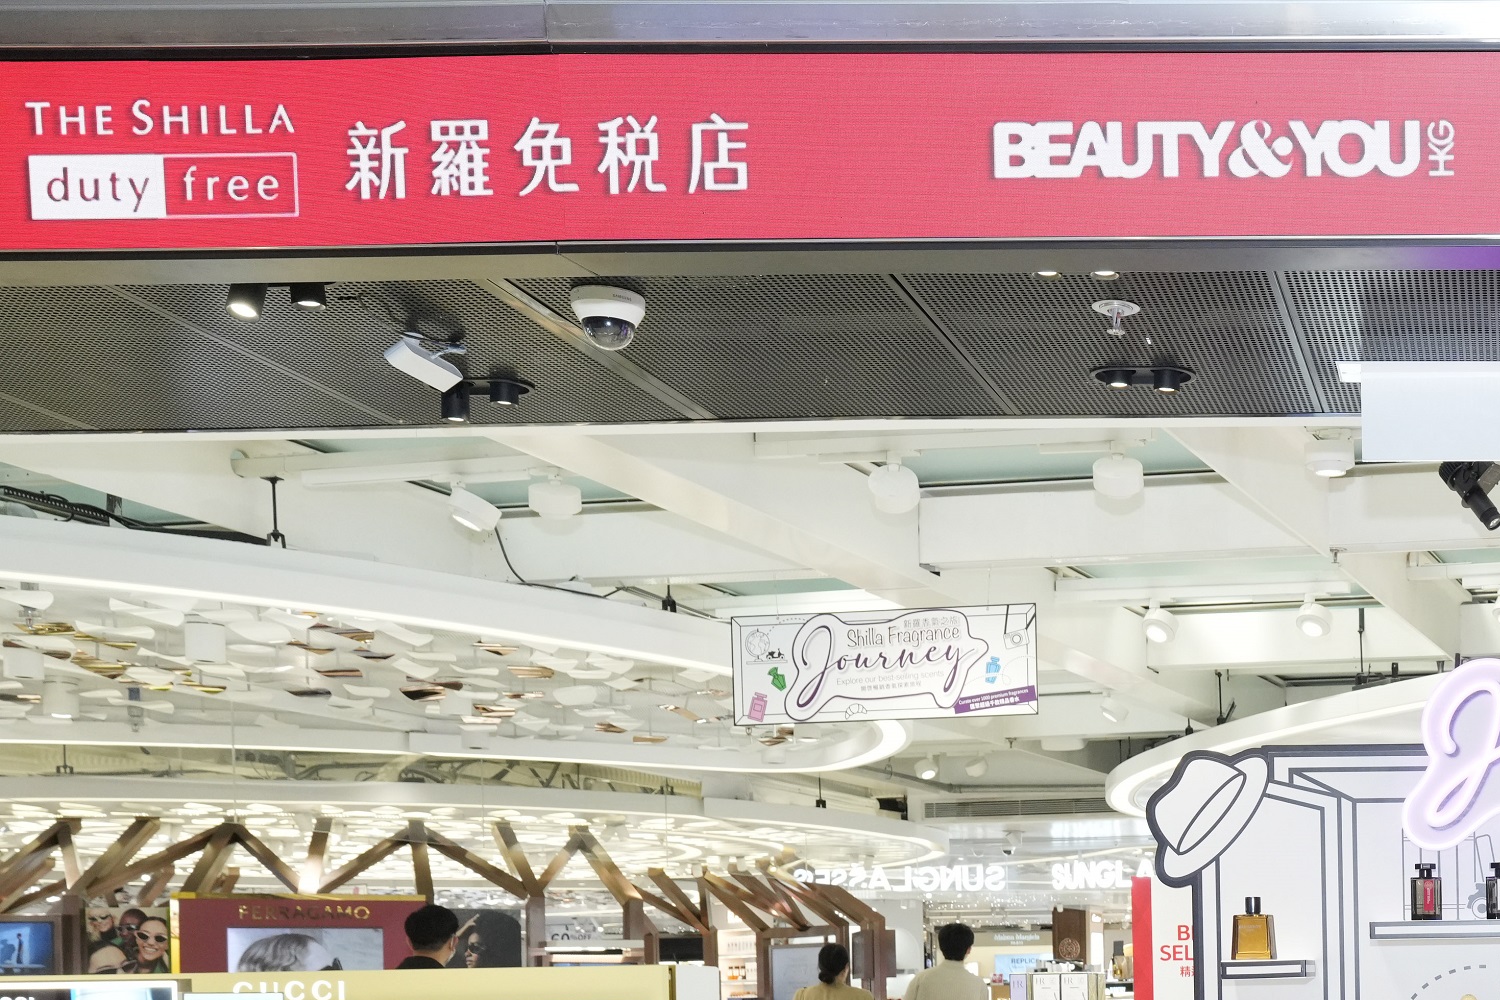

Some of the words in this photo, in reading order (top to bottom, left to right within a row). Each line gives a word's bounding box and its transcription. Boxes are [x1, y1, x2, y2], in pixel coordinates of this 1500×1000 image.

[26, 101, 113, 136] THE
[131, 99, 296, 136] SHILLA
[345, 113, 749, 200] 新羅免税店
[992, 119, 1421, 179] BEAUTY&YOU
[1428, 119, 1455, 177] HKG
[47, 170, 149, 213] duty
[182, 167, 280, 203] free
[847, 628, 884, 648] Shilla
[888, 626, 960, 648] Fragrance
[796, 625, 975, 708] Journey
[836, 677, 864, 687] Explore
[920, 670, 945, 678] scents
[238, 904, 371, 921] FERRAGAMO
[1178, 925, 1194, 941] B
